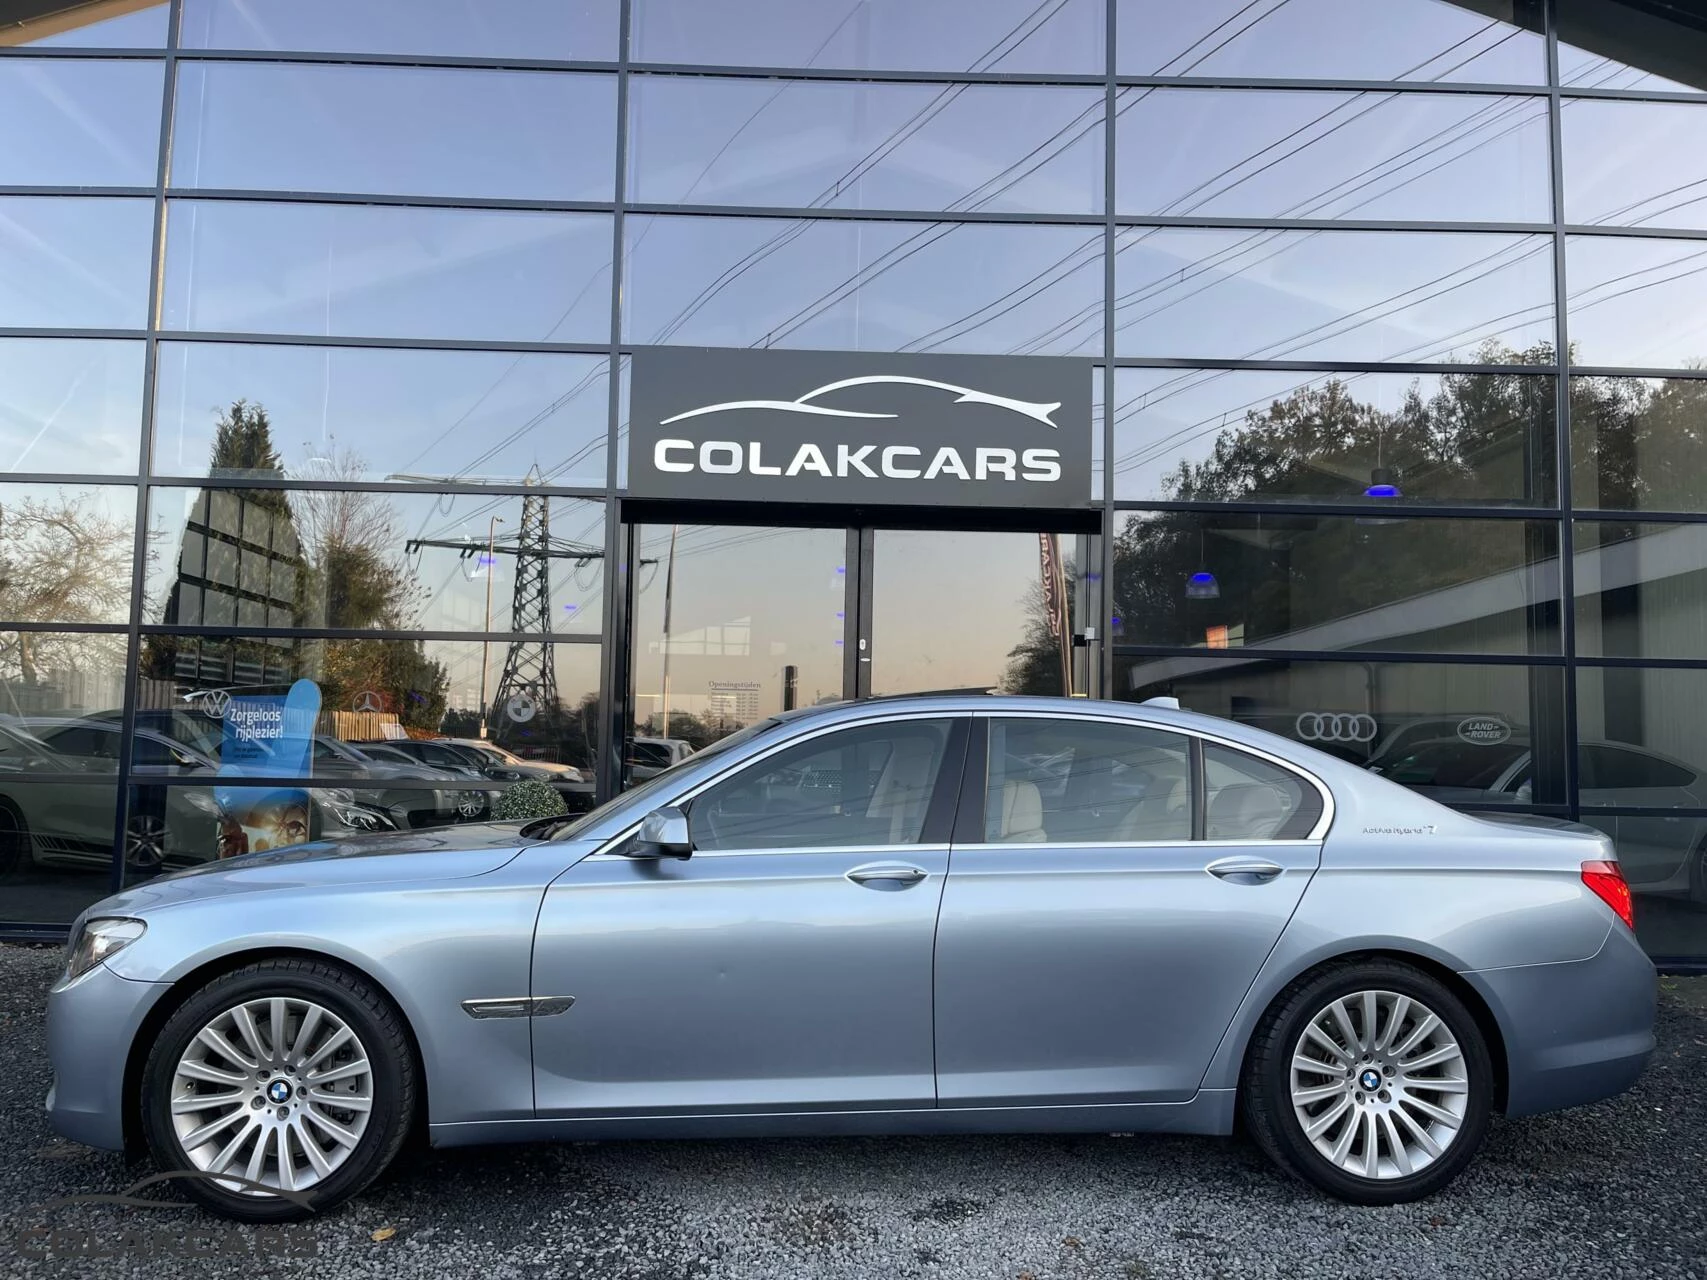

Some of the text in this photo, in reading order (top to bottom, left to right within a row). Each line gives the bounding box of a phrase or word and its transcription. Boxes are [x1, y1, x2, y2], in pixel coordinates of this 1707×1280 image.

[654, 439, 1062, 482] COLAKCARS
[230, 708, 281, 725] Zorgeloos
[235, 726, 283, 742] rijplezier!
[1468, 723, 1494, 731] LAND
[1470, 730, 1501, 739] ROVER
